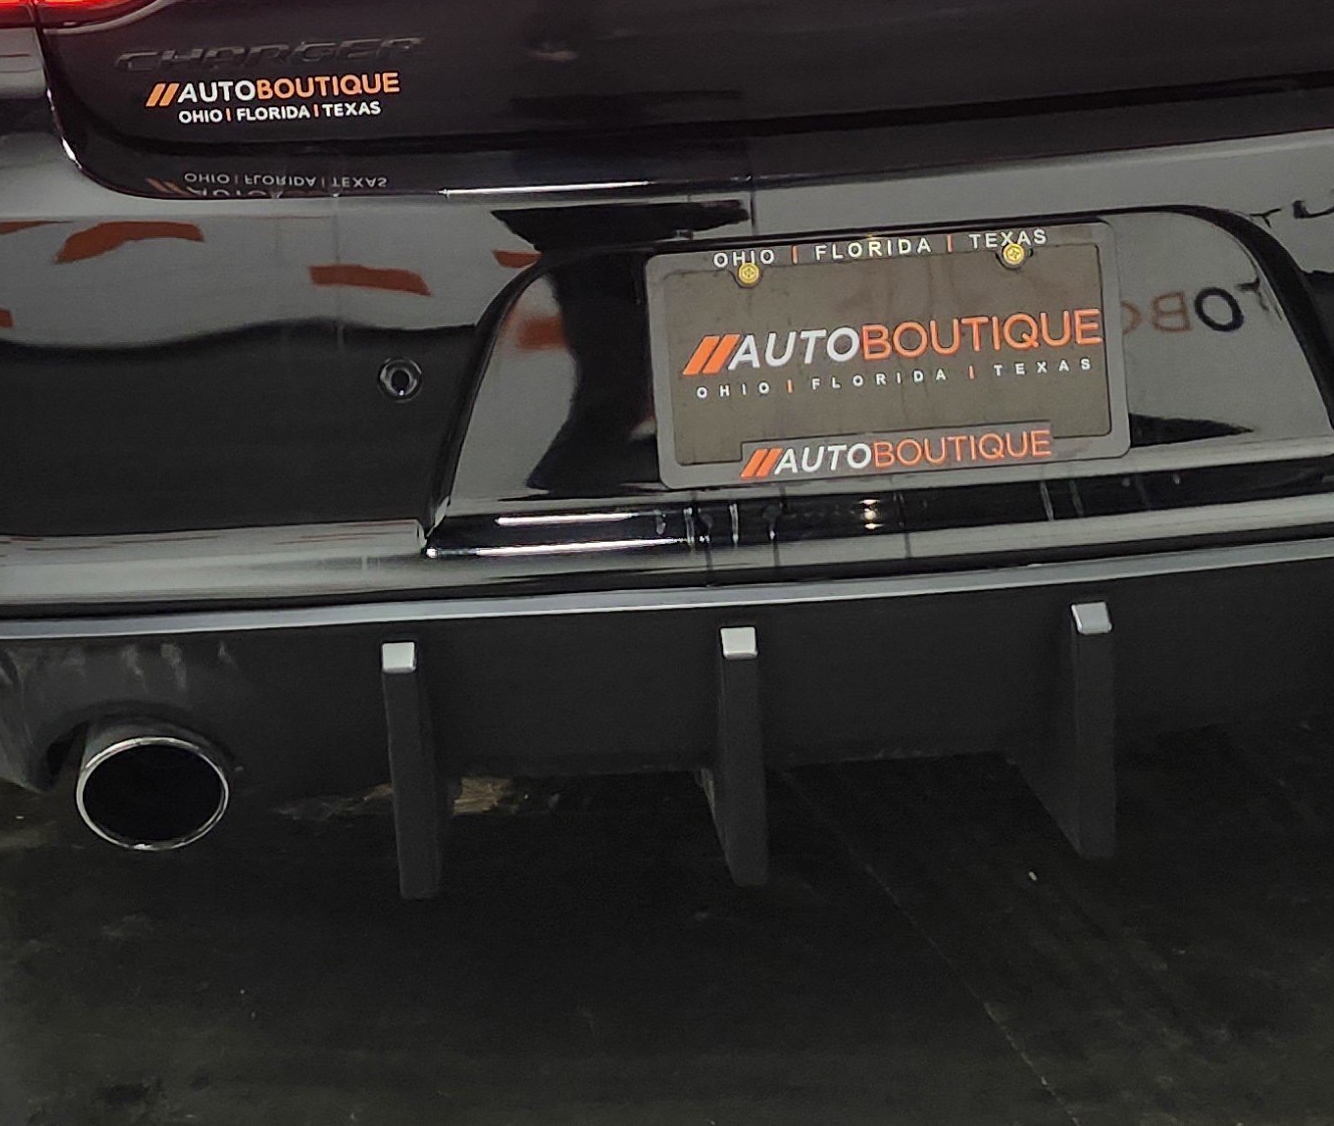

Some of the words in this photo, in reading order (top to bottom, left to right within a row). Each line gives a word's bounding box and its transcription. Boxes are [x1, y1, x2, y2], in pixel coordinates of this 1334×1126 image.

[115, 36, 425, 71] CHARGER
[177, 72, 400, 103] AUTOBOUTIQUE
[178, 109, 223, 124] OHIO
[236, 104, 311, 121] FLORIDA
[322, 100, 381, 118] TEXAS
[712, 249, 775, 269] OHIO
[814, 237, 932, 261] FLORIDA
[968, 228, 1048, 250] TEXAS
[728, 308, 1103, 370] AUTOBOUTIQUE
[696, 381, 770, 398] OHIO
[811, 368, 947, 391] FLORIDA
[993, 358, 1092, 377] TEXAS
[773, 429, 1052, 476] AUTOBOUTIQUE
